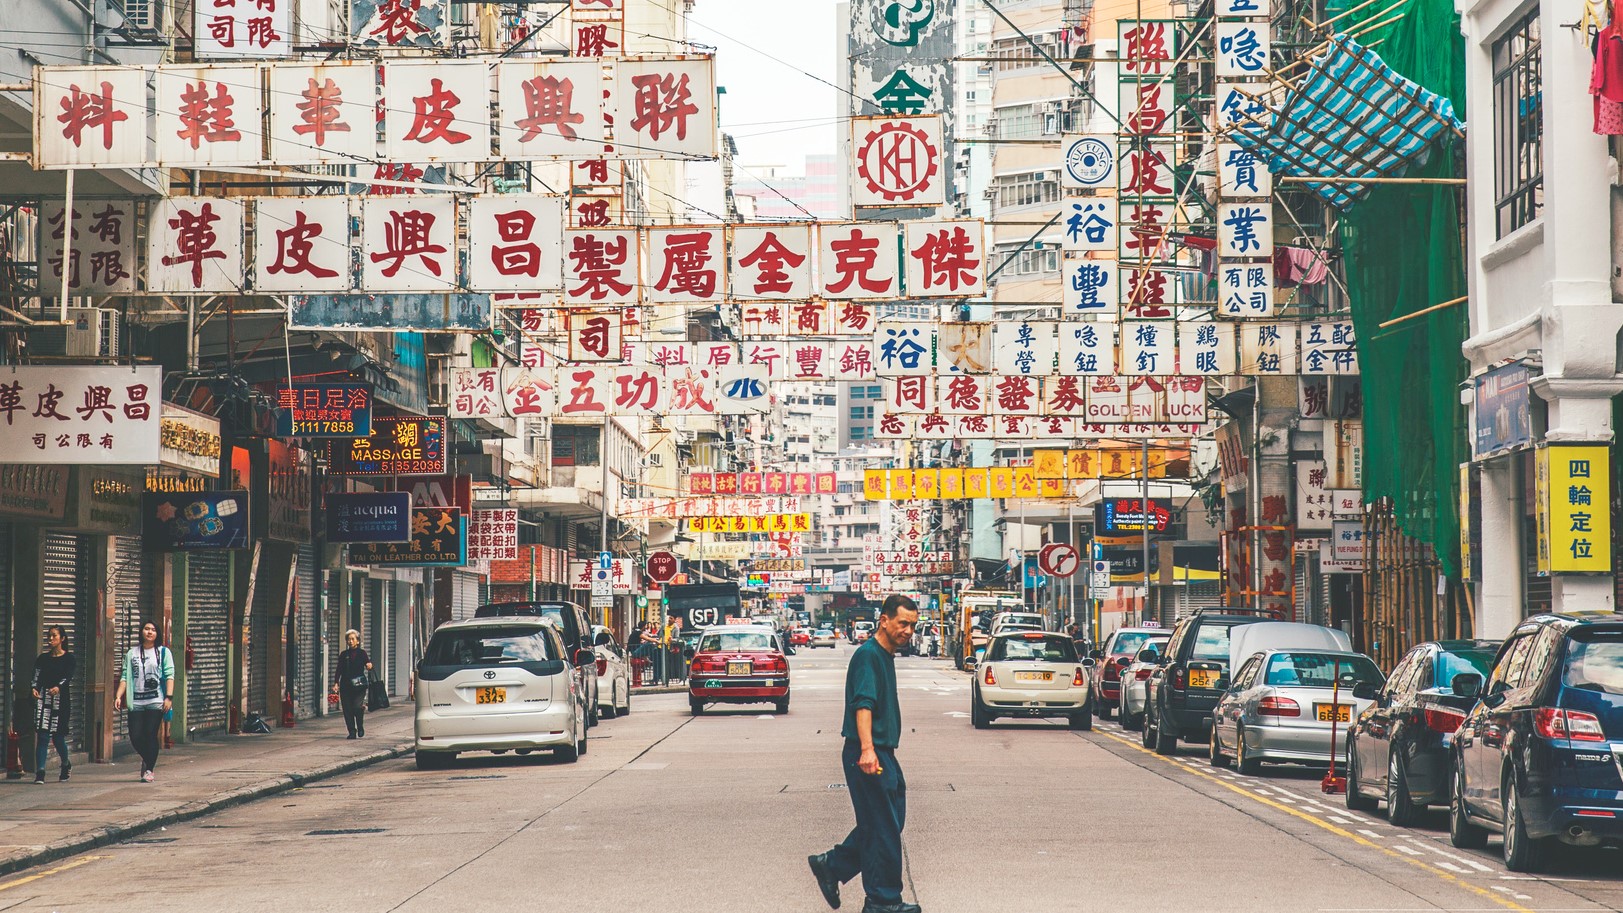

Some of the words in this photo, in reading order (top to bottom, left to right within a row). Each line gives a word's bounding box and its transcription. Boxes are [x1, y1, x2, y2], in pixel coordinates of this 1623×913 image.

[1072, 148, 1084, 168] YUE
[1086, 144, 1107, 168] FUNG
[1066, 203, 1113, 310] 裕豐
[1088, 404, 1152, 418] GOLDEN
[1162, 404, 1204, 418] LUCK
[323, 421, 354, 433] 7858
[351, 450, 422, 461] MASSAGE
[412, 460, 442, 471] 2036
[1568, 459, 1594, 560] 四輪定位
[370, 553, 381, 561] ON
[384, 552, 421, 560] LEATHER
[658, 565, 667, 575] 停
[484, 687, 497, 696] SA
[478, 694, 505, 704] 3343
